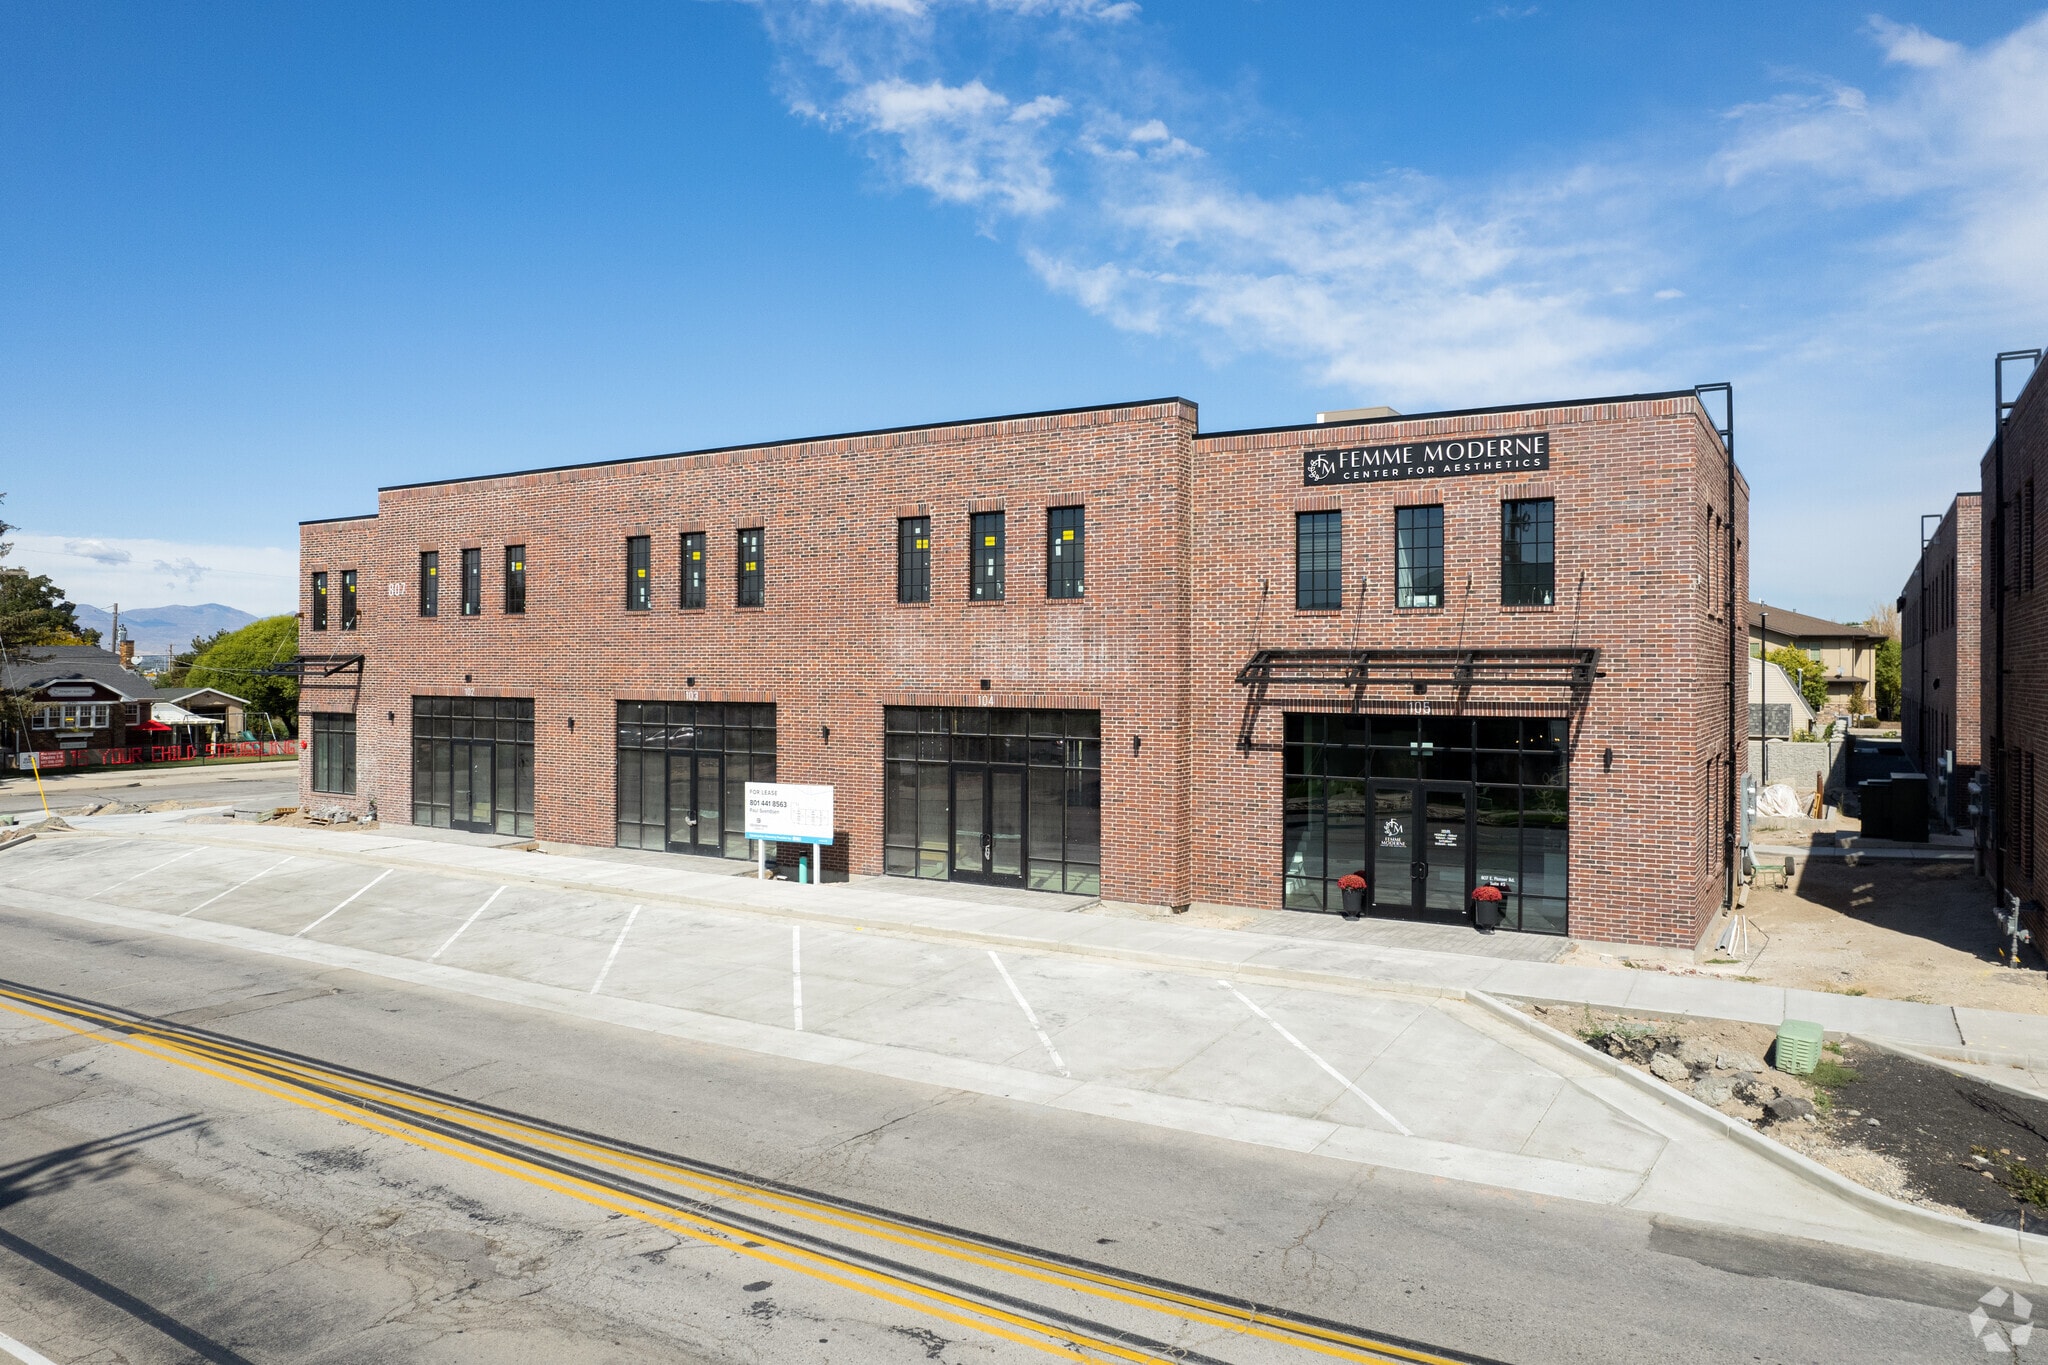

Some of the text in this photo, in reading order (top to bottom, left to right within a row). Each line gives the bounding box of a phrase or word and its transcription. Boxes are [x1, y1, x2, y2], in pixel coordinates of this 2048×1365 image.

[1339, 436, 1546, 469] FEMME MODERNE
[1343, 458, 1541, 480] CENTER FOR AESTHETICS
[389, 583, 405, 596] 807
[685, 691, 699, 701] 103
[978, 695, 994, 707] 104
[1409, 701, 1431, 715] 105
[99, 747, 144, 765] YOUR
[151, 744, 197, 763] CHILD
[772, 800, 787, 808] 8563
